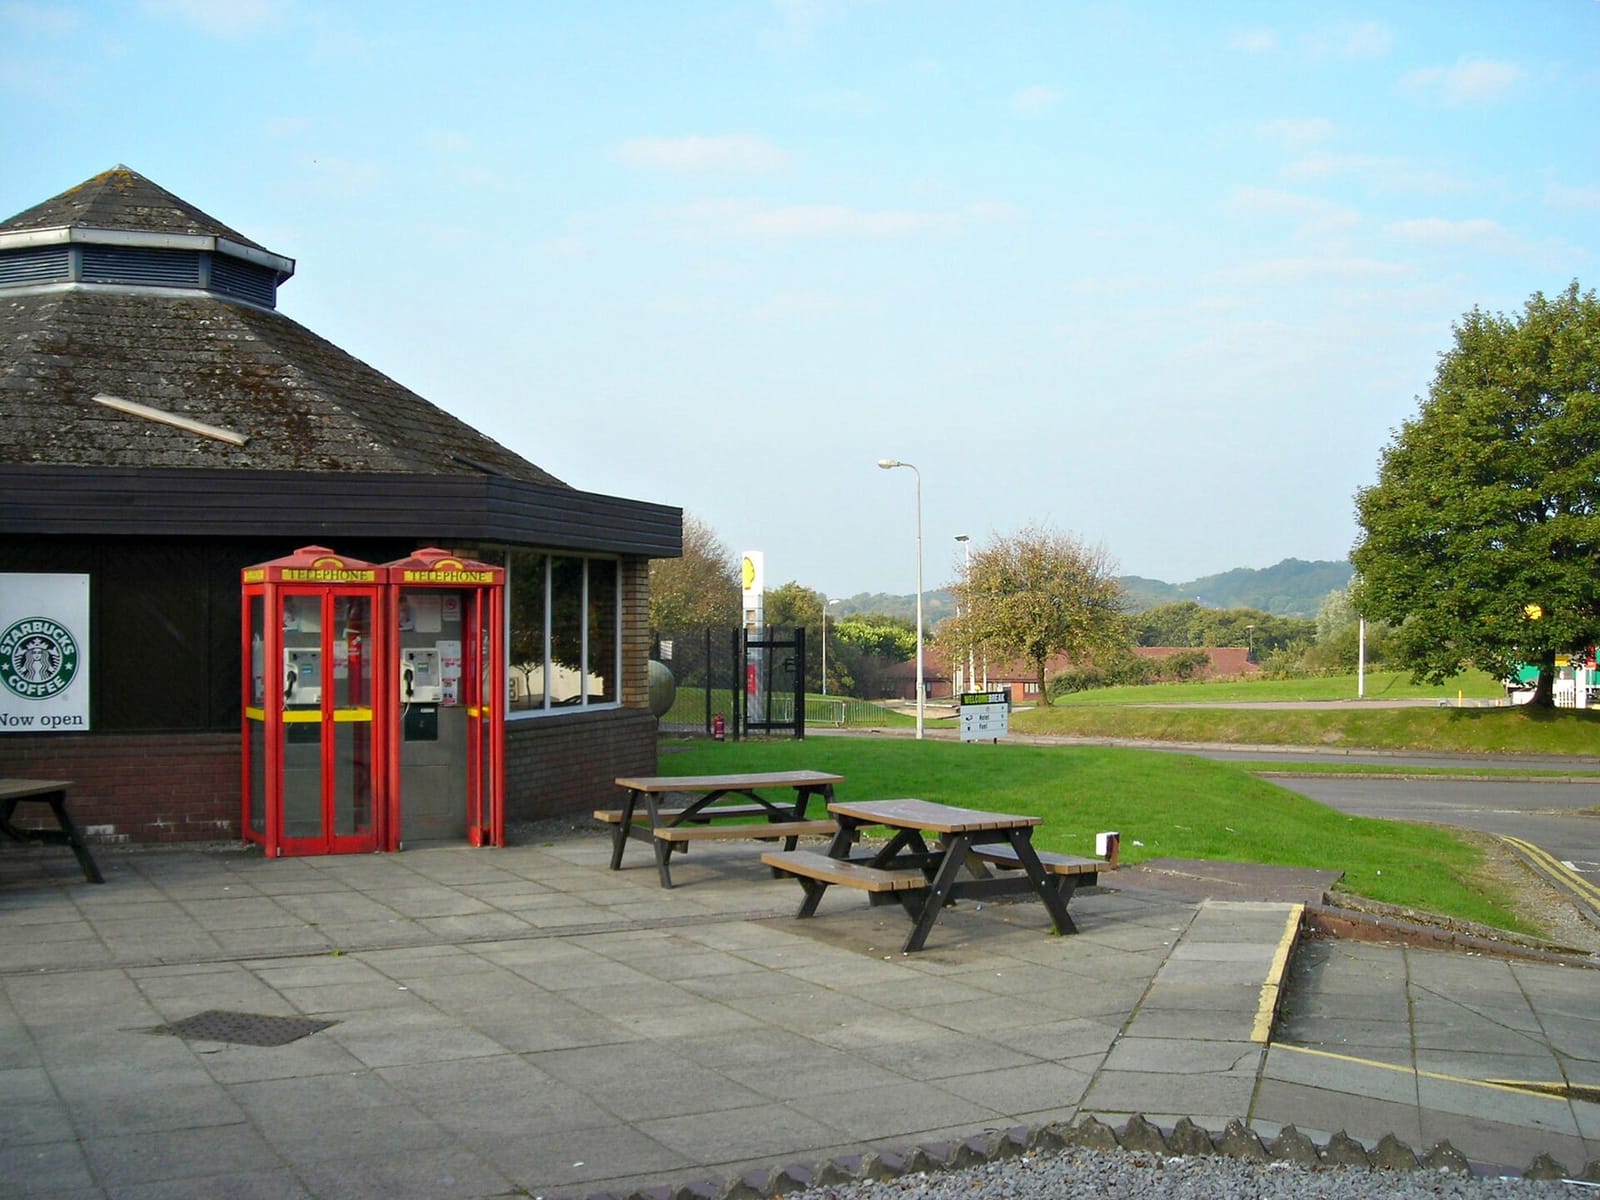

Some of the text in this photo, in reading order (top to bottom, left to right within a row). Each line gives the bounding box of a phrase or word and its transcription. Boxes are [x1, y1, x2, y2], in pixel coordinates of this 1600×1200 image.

[289, 570, 368, 581] TELEPHONE
[411, 571, 486, 581] TELEPHONE
[0, 622, 75, 656] STARBUCKS
[8, 675, 65, 696] COFFEE
[0, 713, 83, 728] Now open
